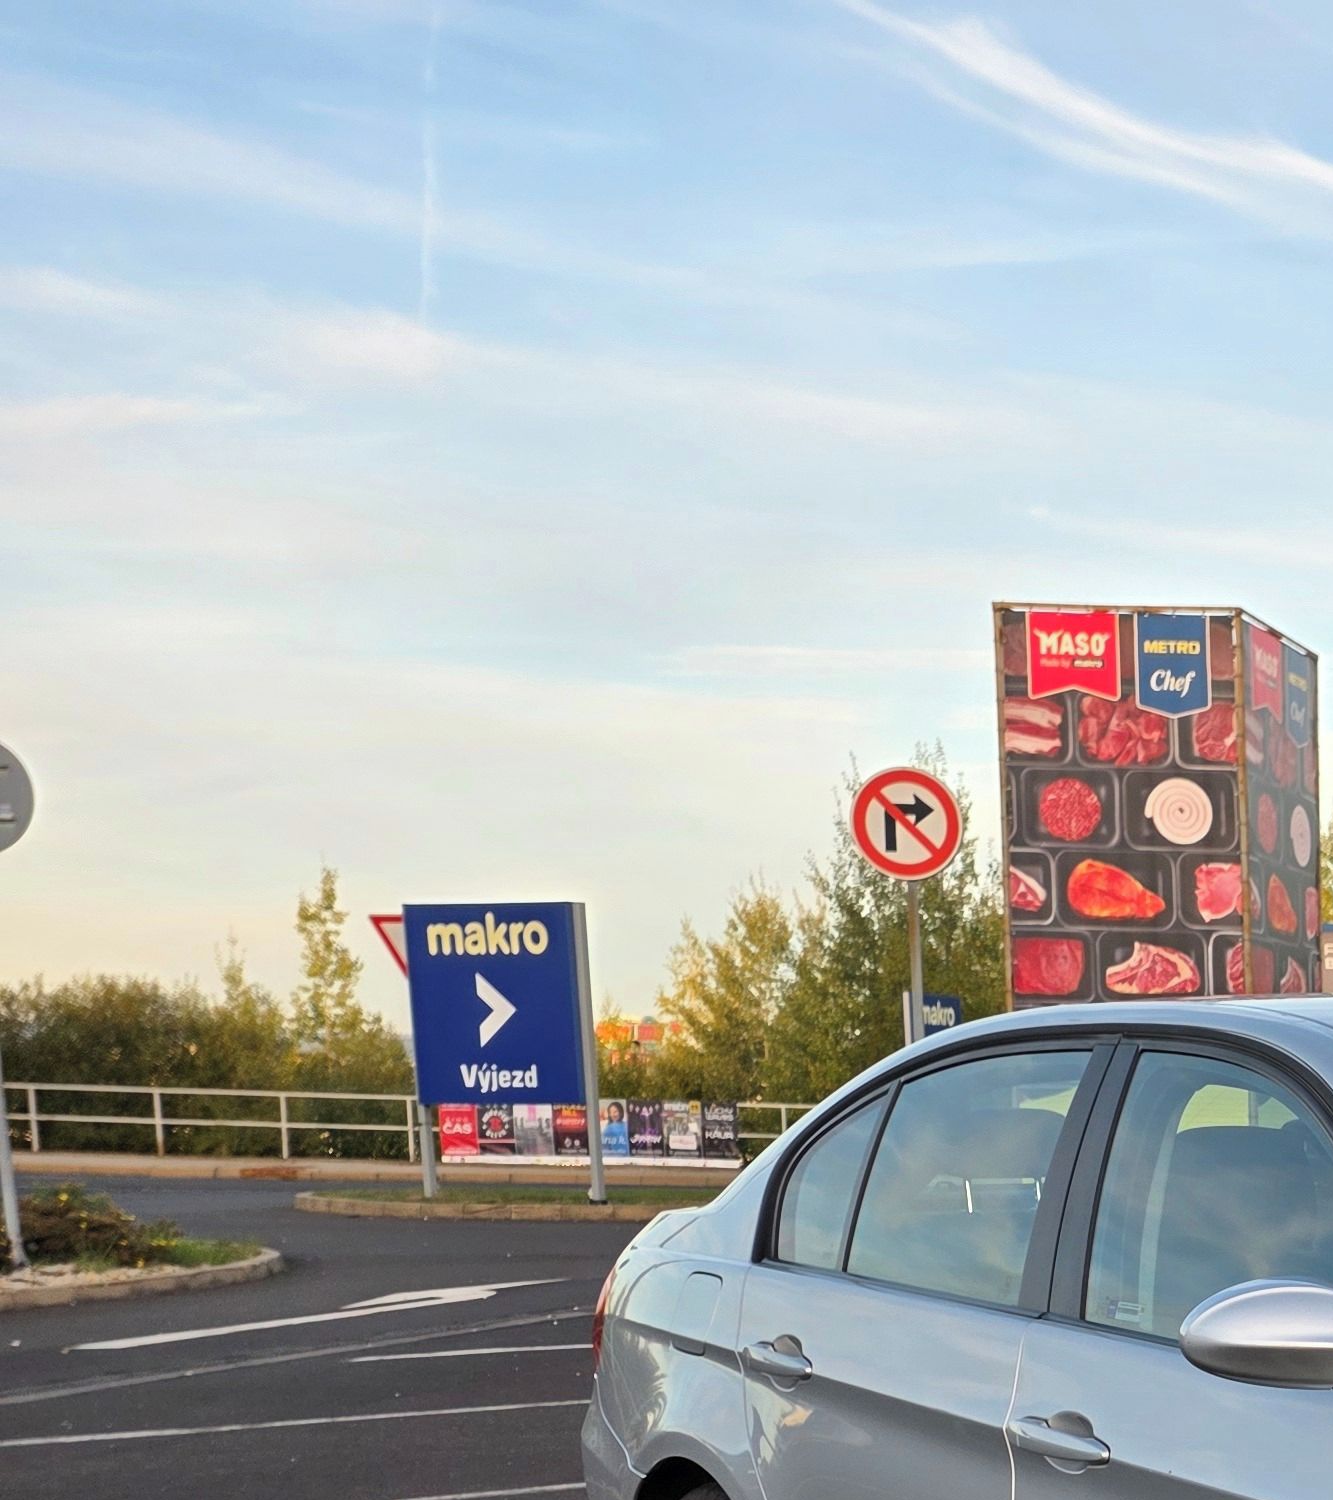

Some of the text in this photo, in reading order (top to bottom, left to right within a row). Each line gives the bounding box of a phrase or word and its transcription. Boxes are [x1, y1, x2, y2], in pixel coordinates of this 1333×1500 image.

[1034, 627, 1112, 657] MASO
[1143, 639, 1201, 655] METRO
[1149, 668, 1196, 698] Chef
[426, 911, 549, 956] makro
[460, 1063, 538, 1094] Výjezd
